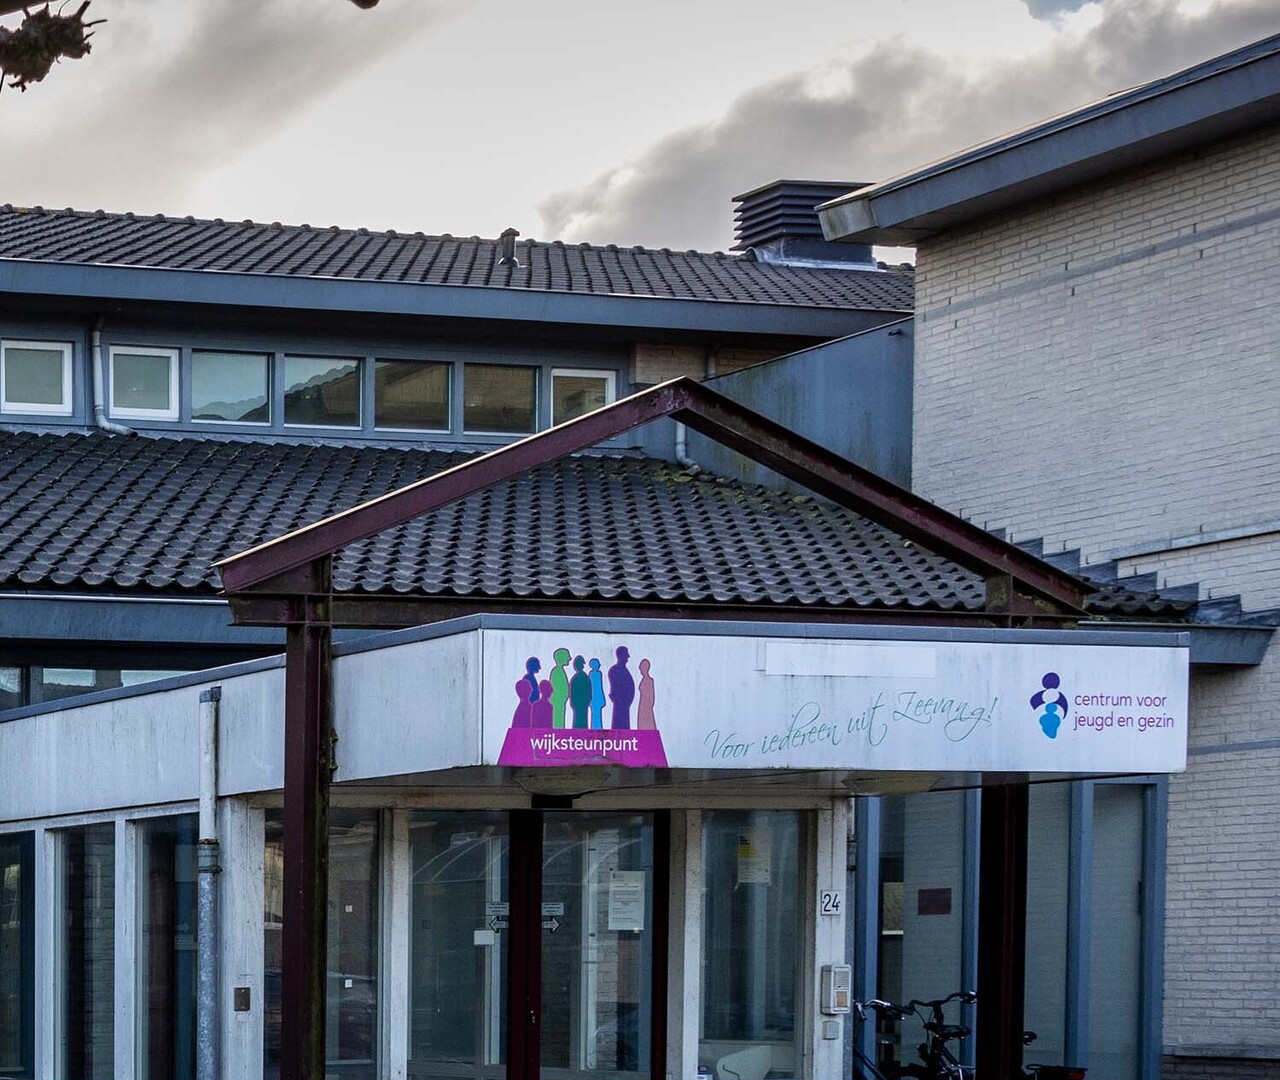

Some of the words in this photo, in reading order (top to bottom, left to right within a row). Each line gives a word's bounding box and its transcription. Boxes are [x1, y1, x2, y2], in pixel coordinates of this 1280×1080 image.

[1074, 693, 1132, 707] centrum
[1136, 696, 1168, 708] voor
[704, 729, 756, 759] Voor
[761, 701, 842, 754] iedereen
[847, 691, 888, 747] uit
[892, 691, 998, 742] Zeevang!
[1073, 711, 1114, 731] jeugd
[1117, 716, 1134, 728] en
[1138, 712, 1175, 732] gezin
[530, 733, 639, 757] wijksteunpunt
[822, 893, 840, 913] 24
